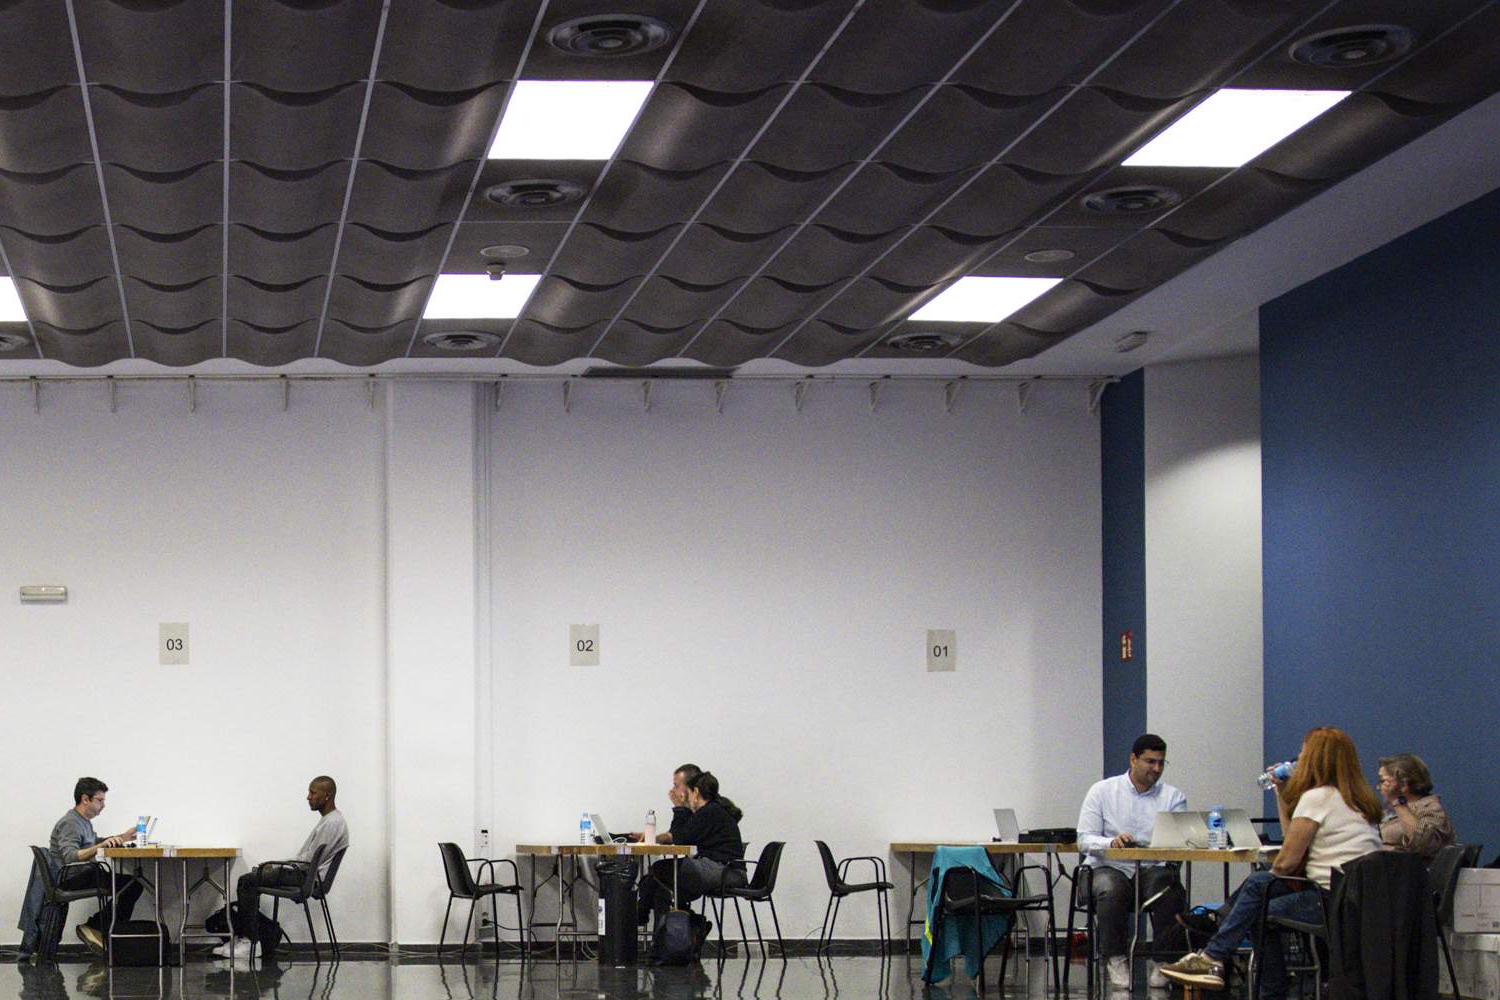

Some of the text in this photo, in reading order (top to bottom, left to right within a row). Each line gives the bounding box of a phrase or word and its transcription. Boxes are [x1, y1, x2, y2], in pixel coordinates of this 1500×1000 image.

[166, 638, 183, 651] 03
[576, 639, 594, 652] 02
[933, 645, 948, 657] 01
